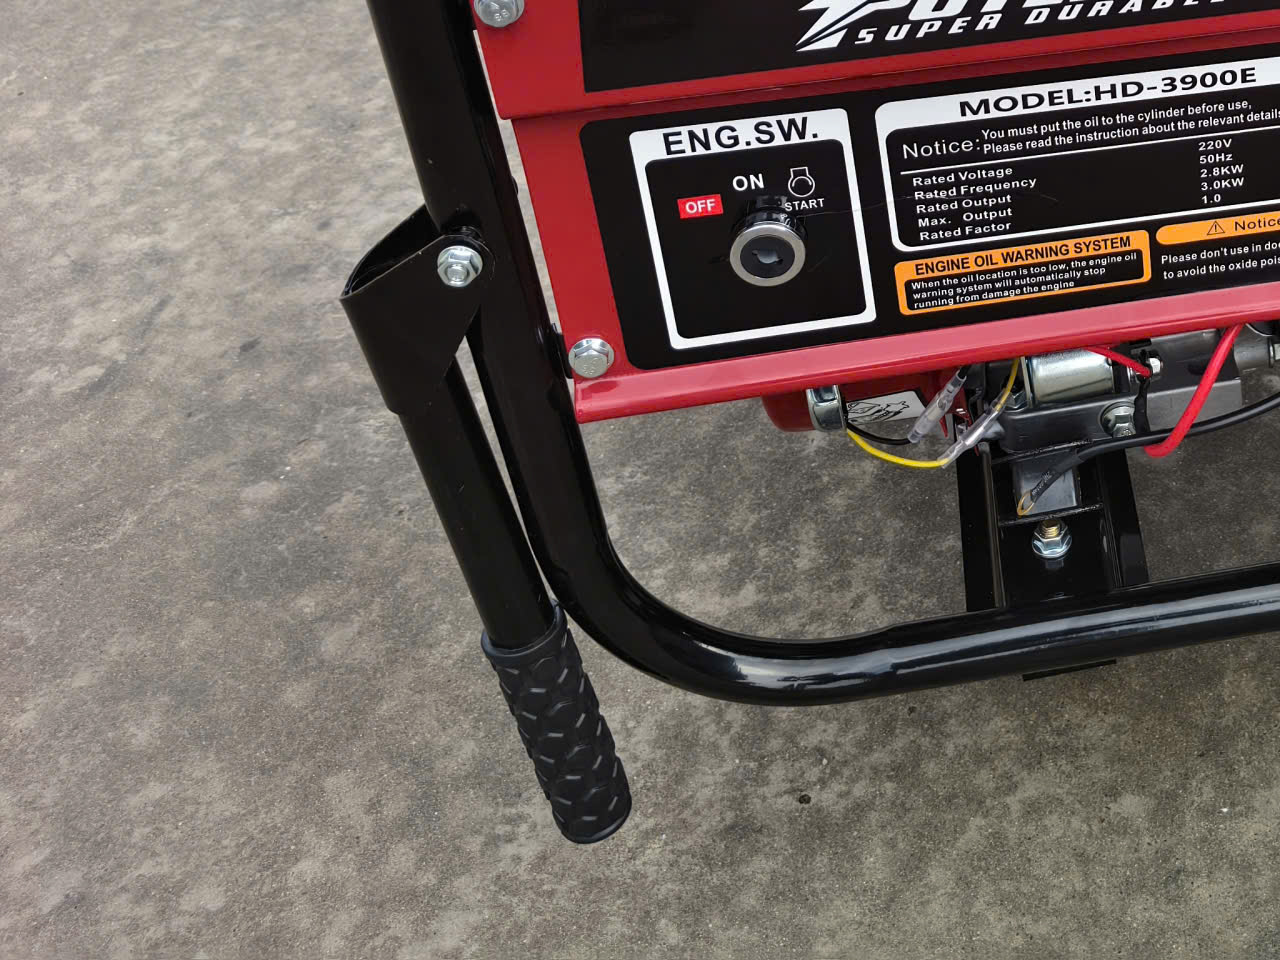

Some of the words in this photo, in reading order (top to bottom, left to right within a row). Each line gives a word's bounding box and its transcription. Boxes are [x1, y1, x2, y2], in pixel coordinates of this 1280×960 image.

[854, 13, 1003, 45] SUPER
[959, 67, 1257, 117] MODEL:HD-3900E
[981, 127, 1005, 140] You
[1007, 123, 1038, 137] must
[1040, 121, 1060, 135] put
[1062, 118, 1081, 130] the
[1084, 116, 1099, 128] oil
[1102, 114, 1113, 125] to
[1116, 111, 1135, 123] the
[1137, 105, 1185, 123] cylinder
[1188, 101, 1225, 115] before
[1227, 99, 1252, 111] use,
[662, 116, 819, 156] ENG.SW.
[983, 140, 1023, 154] Please
[1026, 135, 1052, 149] read
[1054, 133, 1073, 146] the
[1075, 126, 1139, 143] instruction
[1142, 122, 1175, 136] about
[1177, 118, 1195, 130] the
[1198, 115, 1244, 128] relevant
[1198, 138, 1233, 151] 220V
[902, 138, 981, 160] Notice:
[1199, 152, 1233, 164] 50Hz
[732, 173, 765, 191] ON
[913, 173, 955, 187] Rated
[958, 167, 1013, 181] Voltage
[1200, 164, 1244, 178] 2.8KW
[914, 187, 957, 200] Rated
[960, 178, 1037, 195] Frequency
[1201, 177, 1245, 191] 3.0KW
[685, 198, 716, 214] OFF
[784, 198, 825, 211] START
[916, 201, 958, 214] Rated
[962, 194, 1012, 208] Output
[1201, 193, 1221, 204] 1.0
[918, 216, 952, 228] Max.
[962, 208, 1013, 222] Output
[920, 227, 962, 241] Rated
[965, 221, 1012, 235] Factor
[914, 257, 971, 276] ENGINE
[974, 252, 999, 268] OIL
[1001, 243, 1070, 264] WARNING
[1073, 235, 1131, 254] SYSTEM
[1161, 253, 1197, 265] Please
[1200, 247, 1228, 259] don't
[1230, 246, 1249, 255] use
[1252, 243, 1262, 253] in
[911, 278, 940, 290] When
[942, 276, 958, 286] the
[961, 274, 974, 284] oil
[976, 269, 1017, 282] location
[1019, 266, 1028, 276] is
[1030, 264, 1046, 274] too
[1048, 262, 1069, 272] low,
[1071, 259, 1087, 269] the
[1089, 255, 1122, 268] engine
[1124, 252, 1137, 262] oil
[1163, 270, 1174, 280] to
[1177, 265, 1206, 278] avoid
[1209, 263, 1226, 273] the
[1228, 258, 1258, 271] oxide
[912, 287, 954, 299] warning
[956, 282, 993, 295] system
[995, 278, 1012, 288] will
[1014, 271, 1081, 286] automatically
[1083, 266, 1106, 277] stop
[914, 297, 954, 309] running
[956, 293, 980, 303] from
[982, 288, 1021, 300] damage
[1022, 285, 1039, 294] the
[1041, 280, 1075, 292] engine
